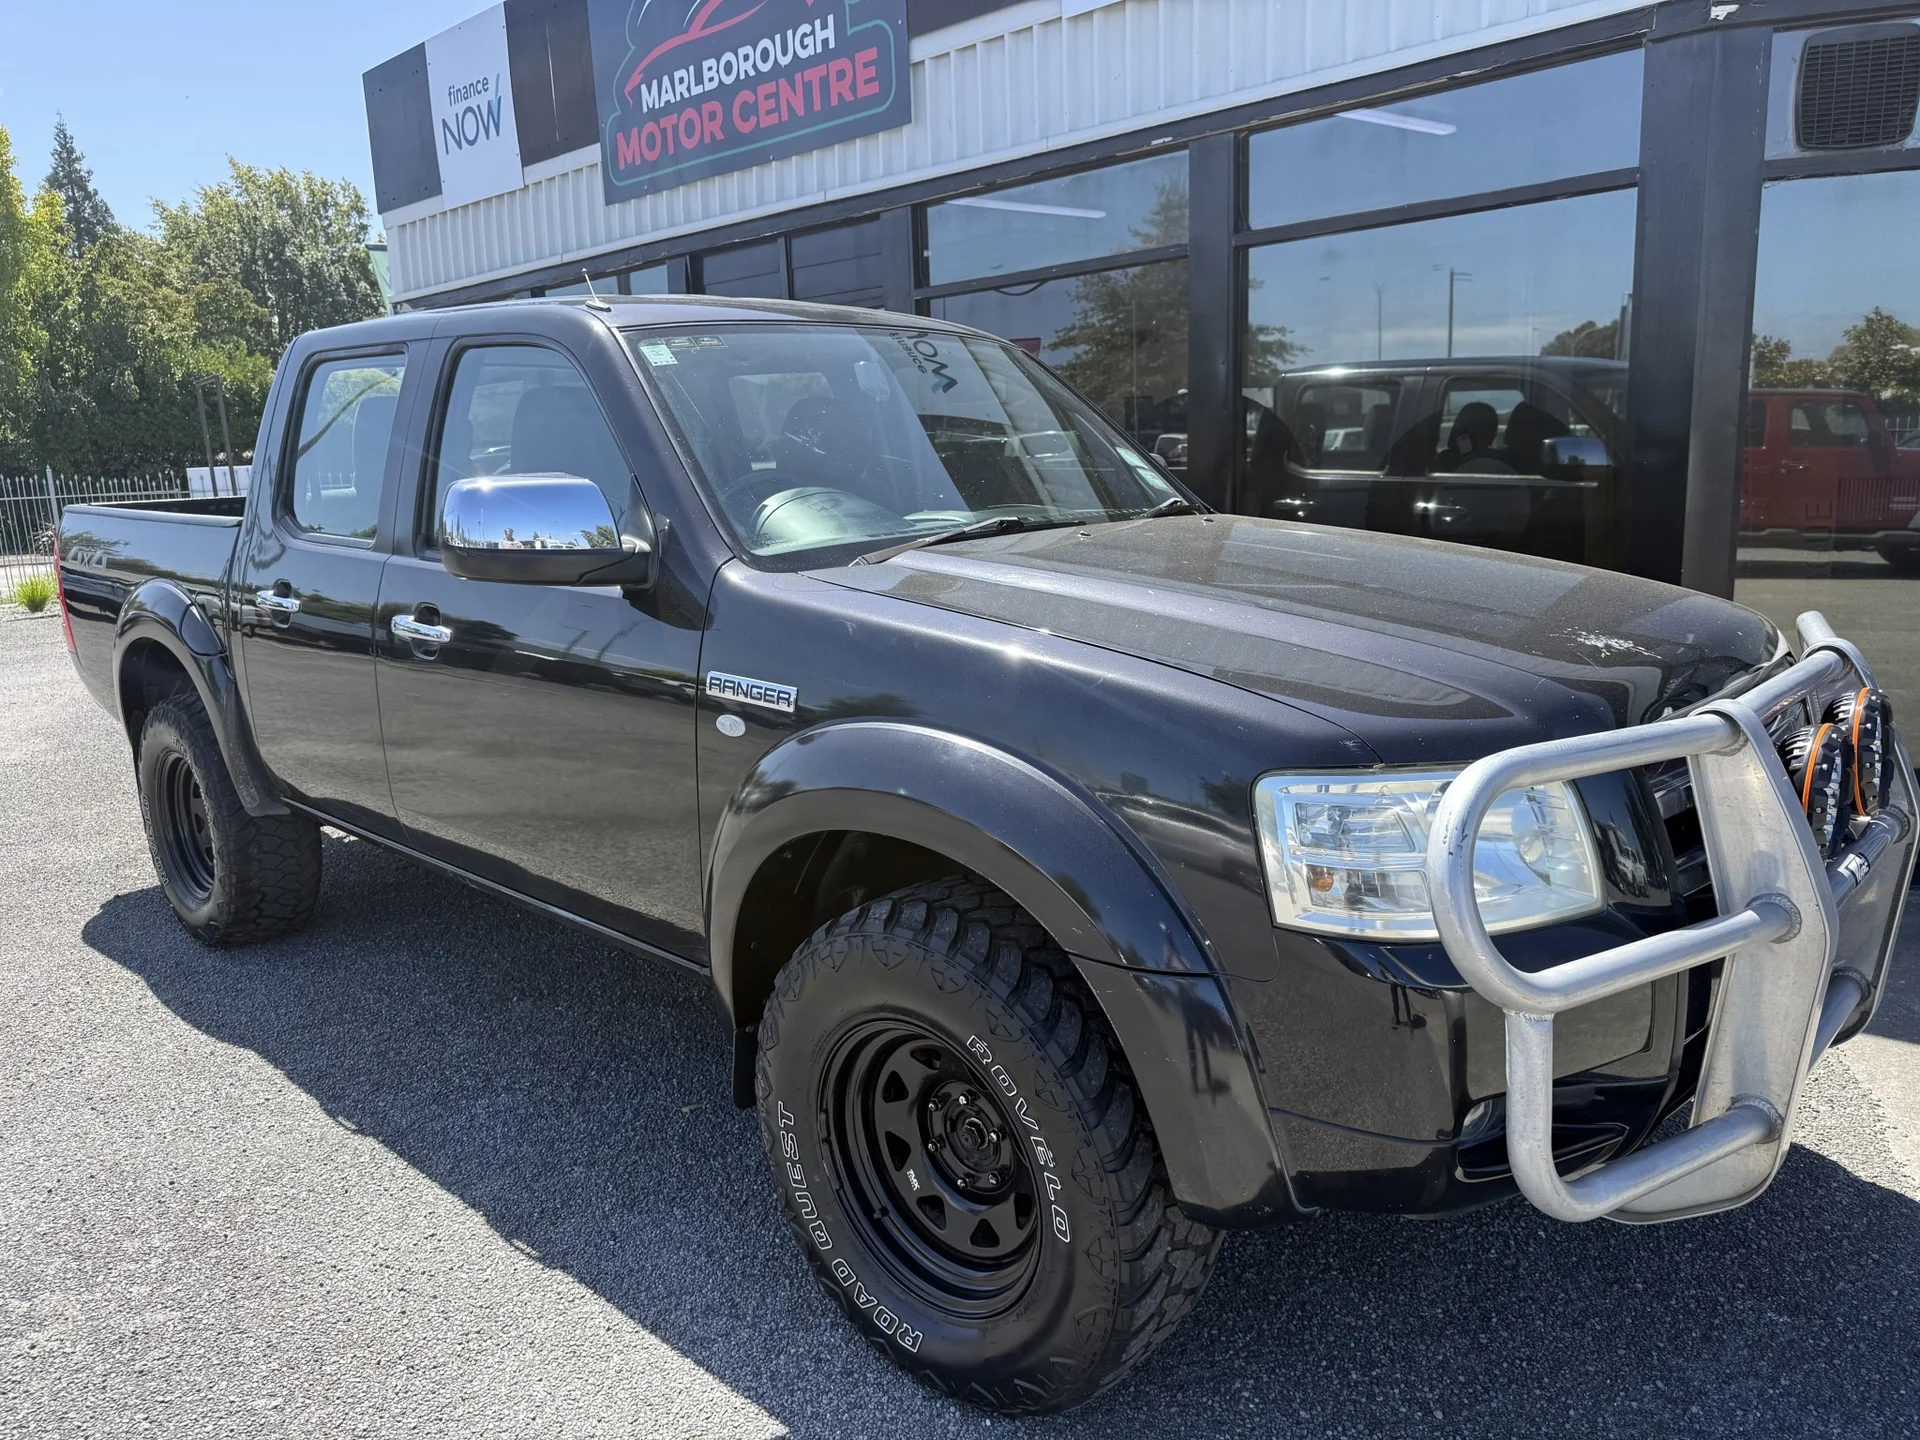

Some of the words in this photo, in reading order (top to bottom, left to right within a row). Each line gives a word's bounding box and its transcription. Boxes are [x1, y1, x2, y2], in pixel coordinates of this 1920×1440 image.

[448, 76, 489, 107] finance
[616, 101, 725, 170] MOTOR
[732, 46, 880, 134] CENTRE
[640, 14, 836, 114] MARLBOROUGH
[442, 88, 502, 155] NOW
[708, 676, 793, 707] RANGER
[778, 1100, 833, 1250] QUEST
[831, 1258, 923, 1353] ROAD
